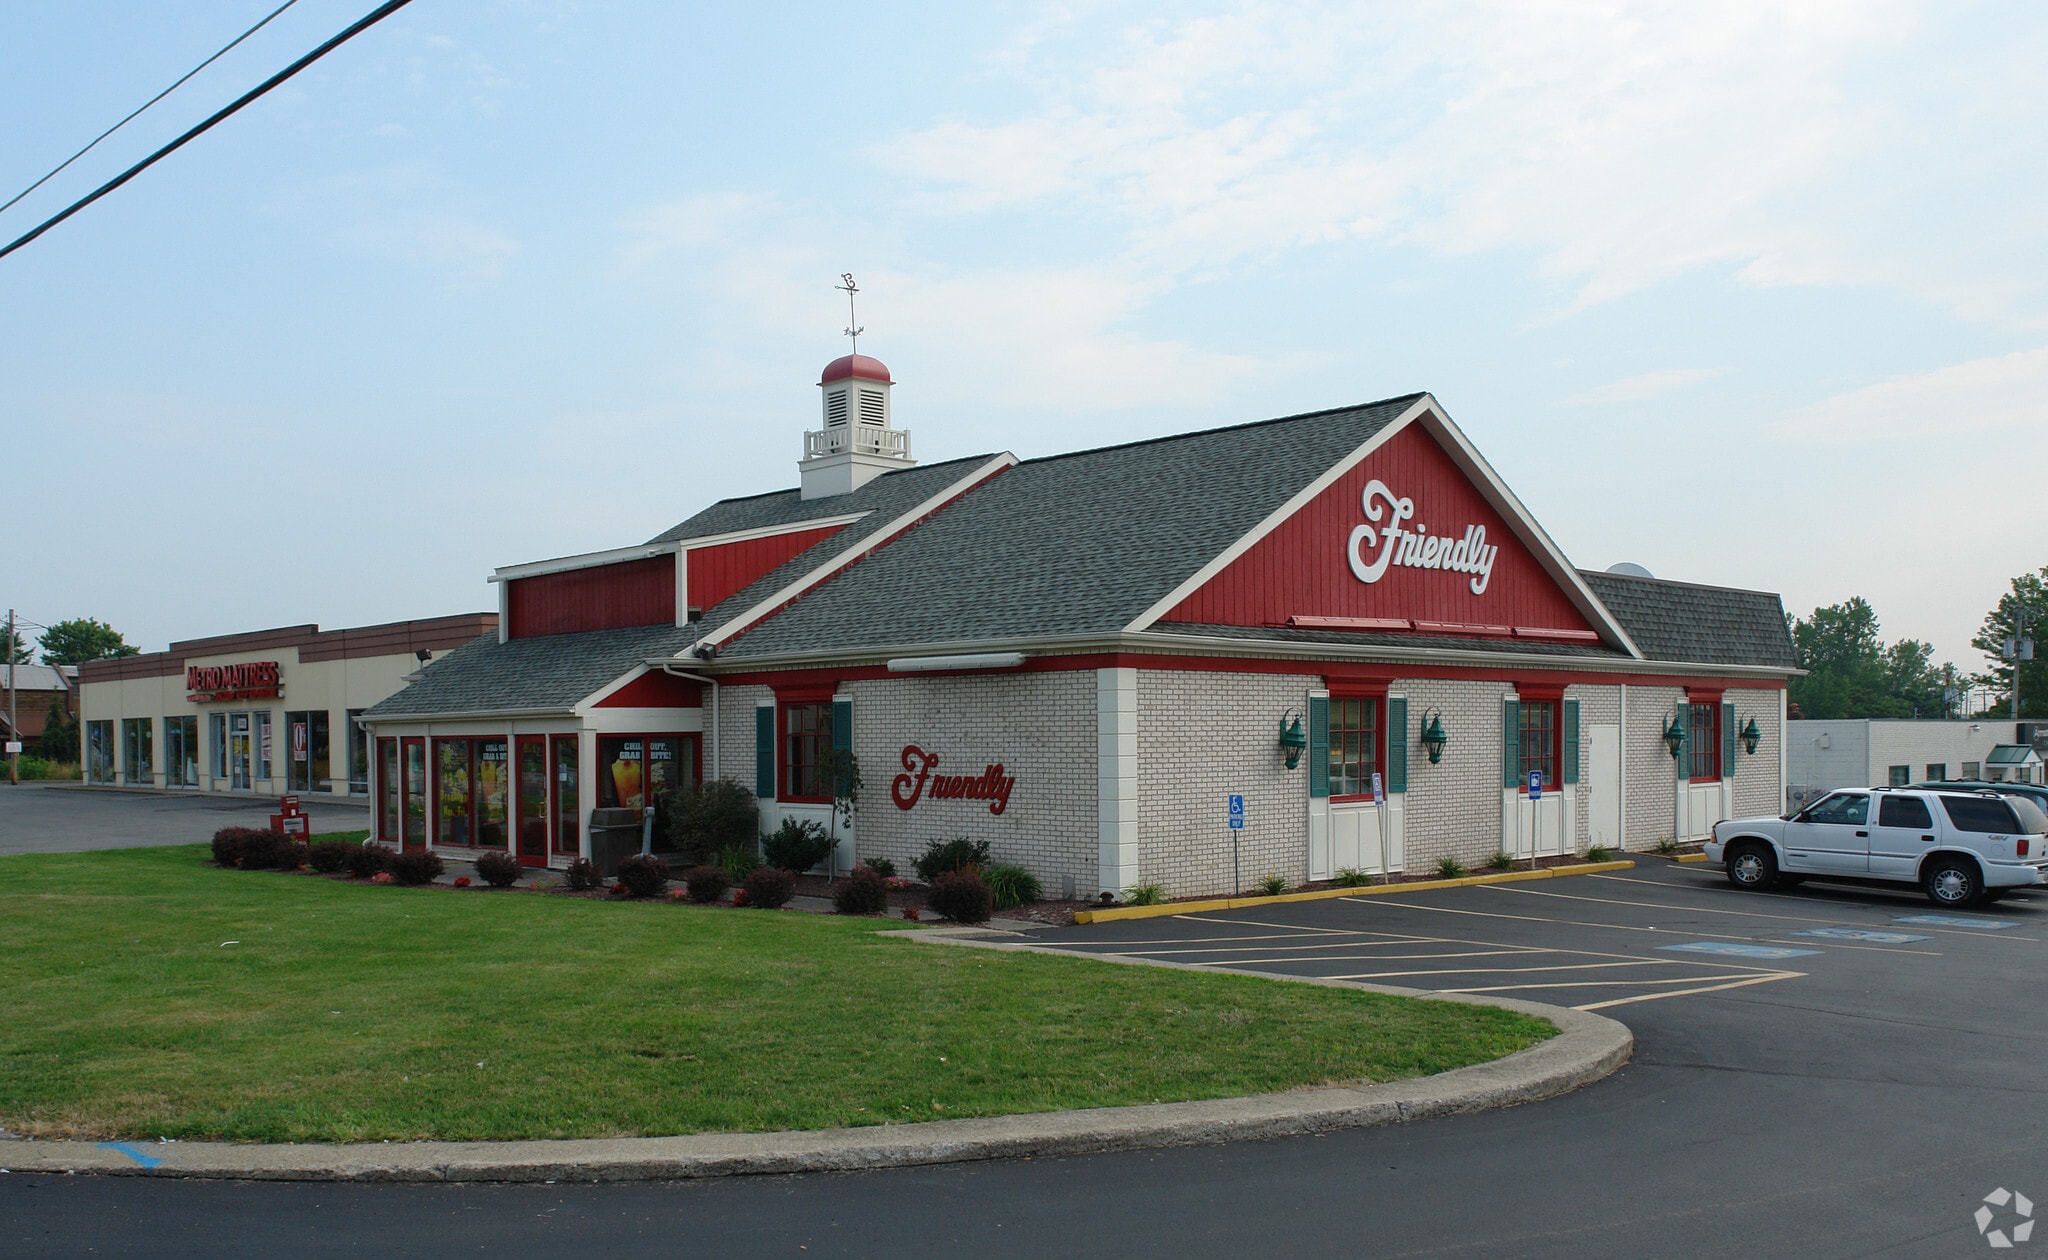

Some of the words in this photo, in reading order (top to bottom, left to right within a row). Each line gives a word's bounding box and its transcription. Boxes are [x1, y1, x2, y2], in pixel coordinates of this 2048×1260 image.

[1347, 479, 1498, 595] Friendly
[187, 666, 222, 691] METRO
[222, 661, 279, 689] MATTRESS
[650, 751, 672, 760] BITE!
[891, 744, 1015, 815] Friendly
